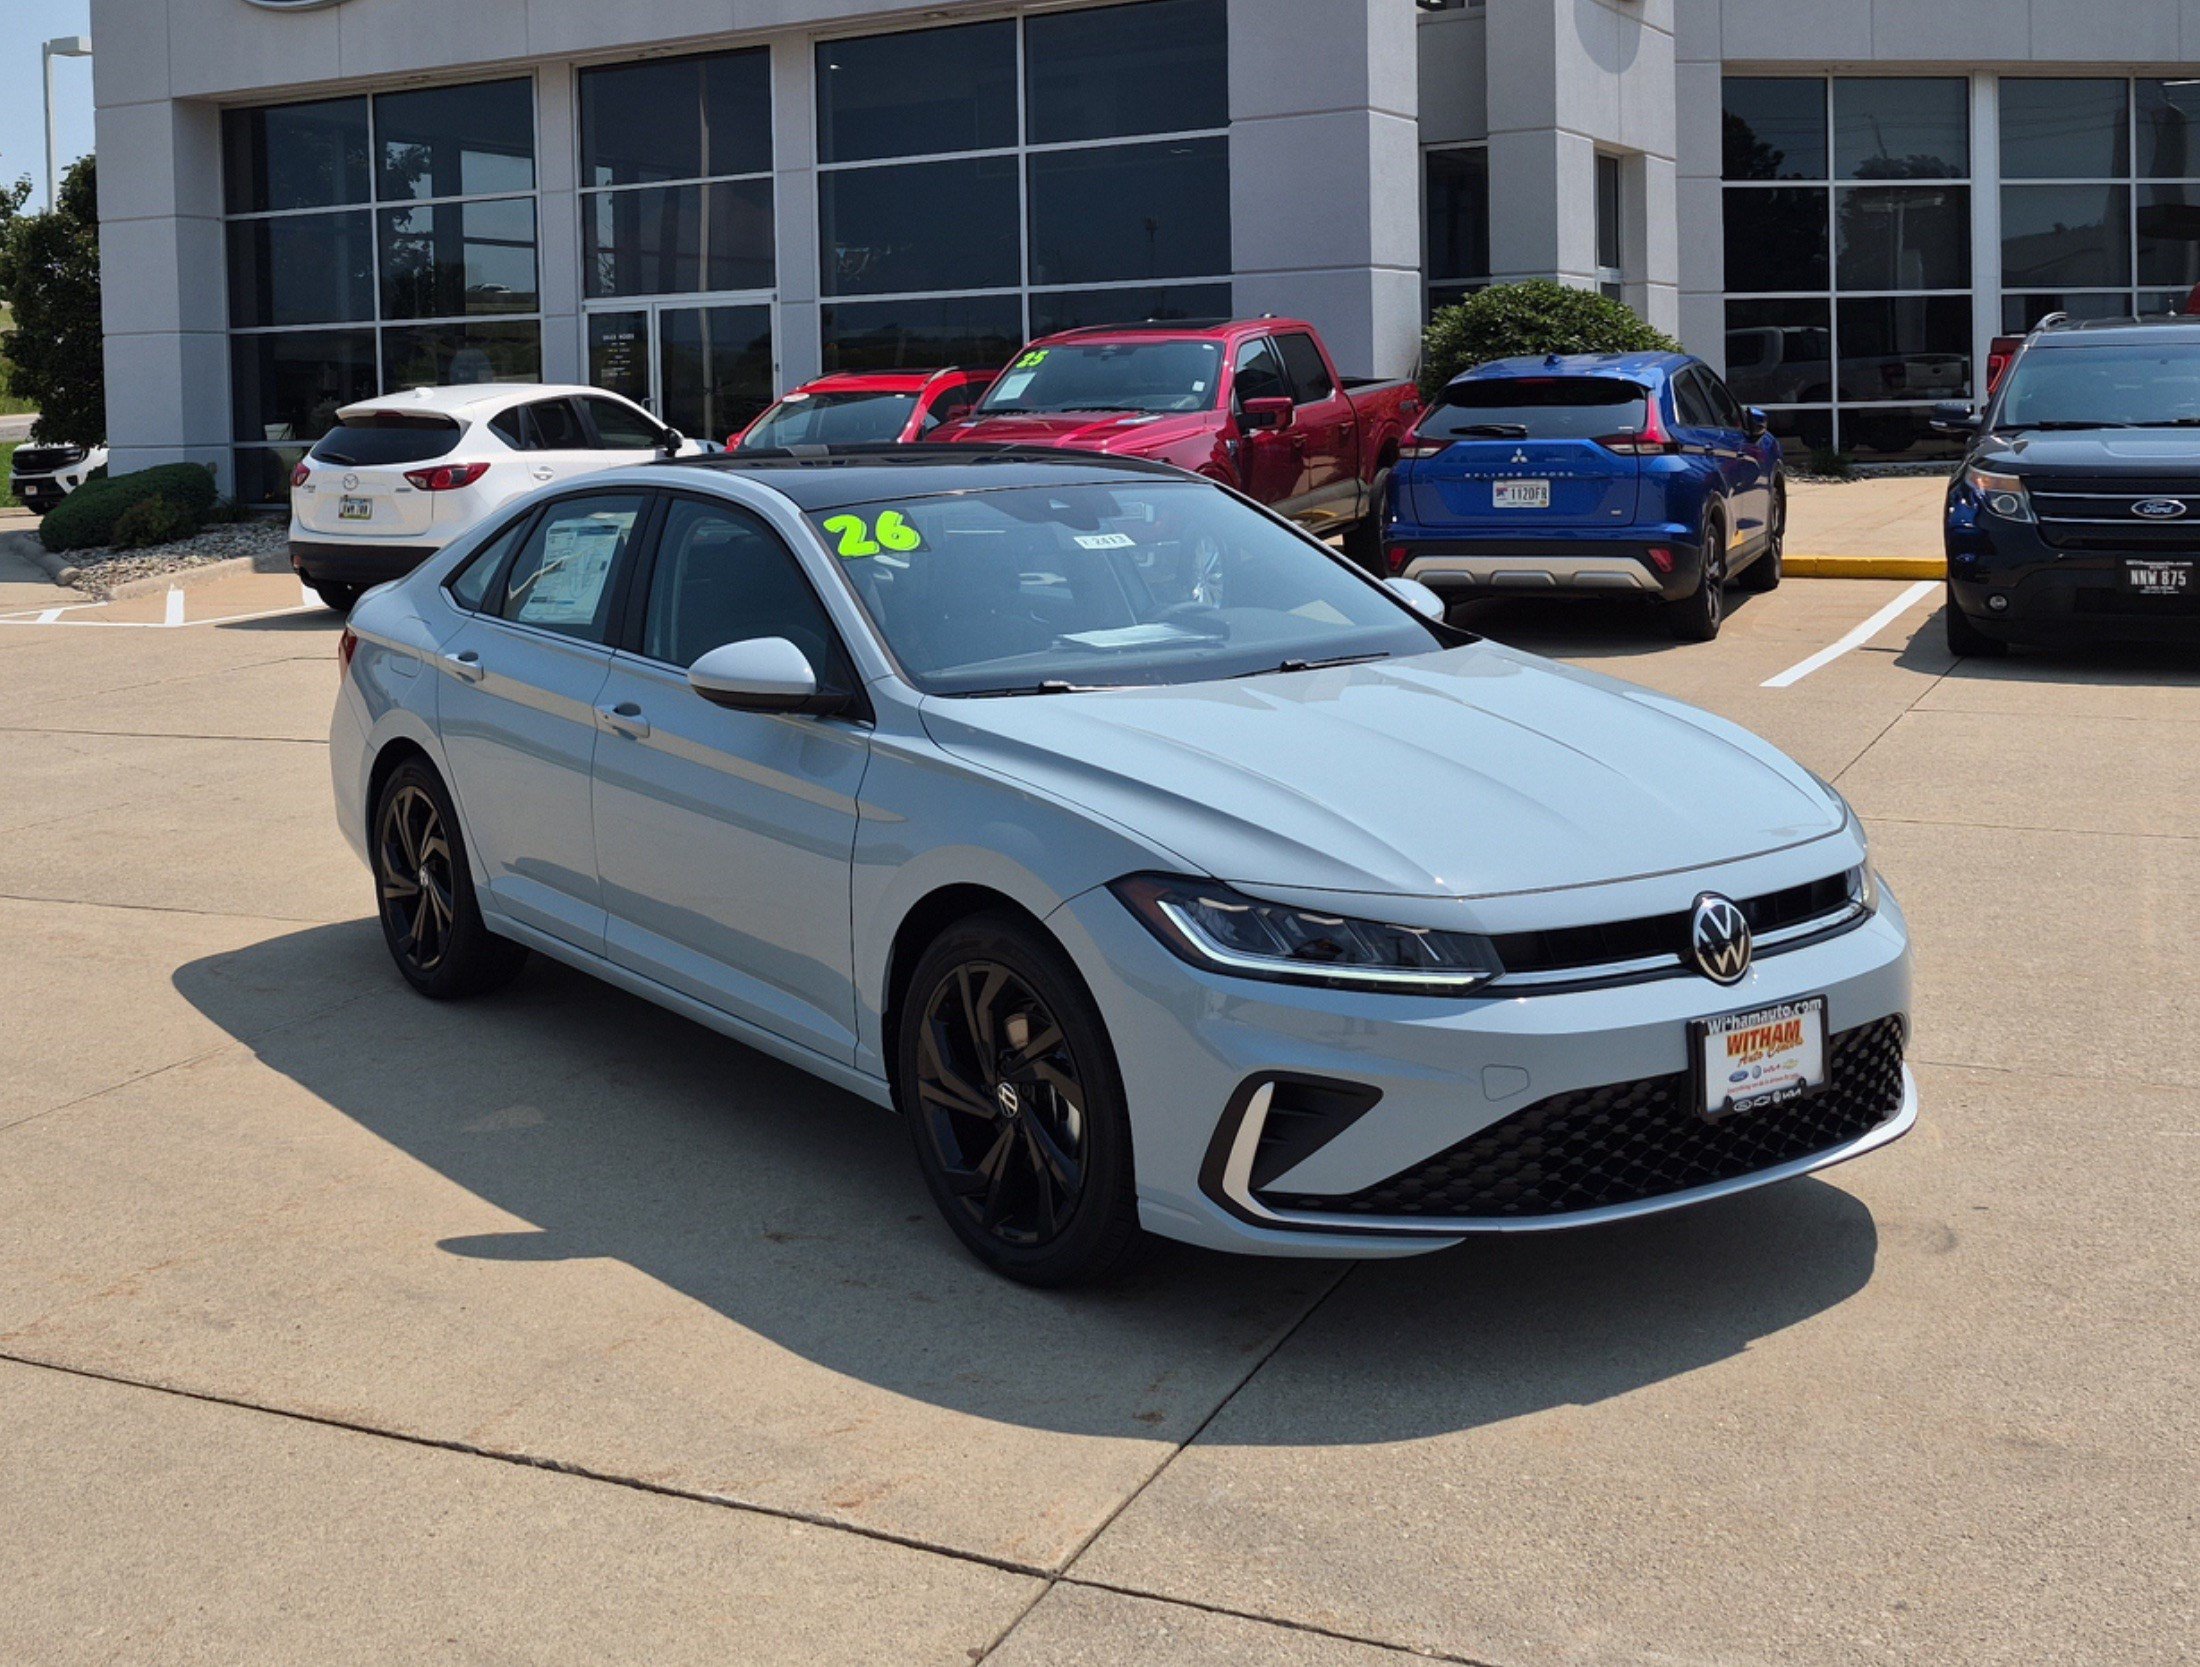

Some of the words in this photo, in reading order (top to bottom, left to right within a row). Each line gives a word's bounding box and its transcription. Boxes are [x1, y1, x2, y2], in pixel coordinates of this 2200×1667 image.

[1016, 349, 1050, 369] 25
[2143, 503, 2174, 514] Ford
[823, 510, 921, 557] 26
[2130, 569, 2158, 586] NNW
[2161, 569, 2187, 587] 875
[1727, 1018, 1802, 1057] WITHAM
